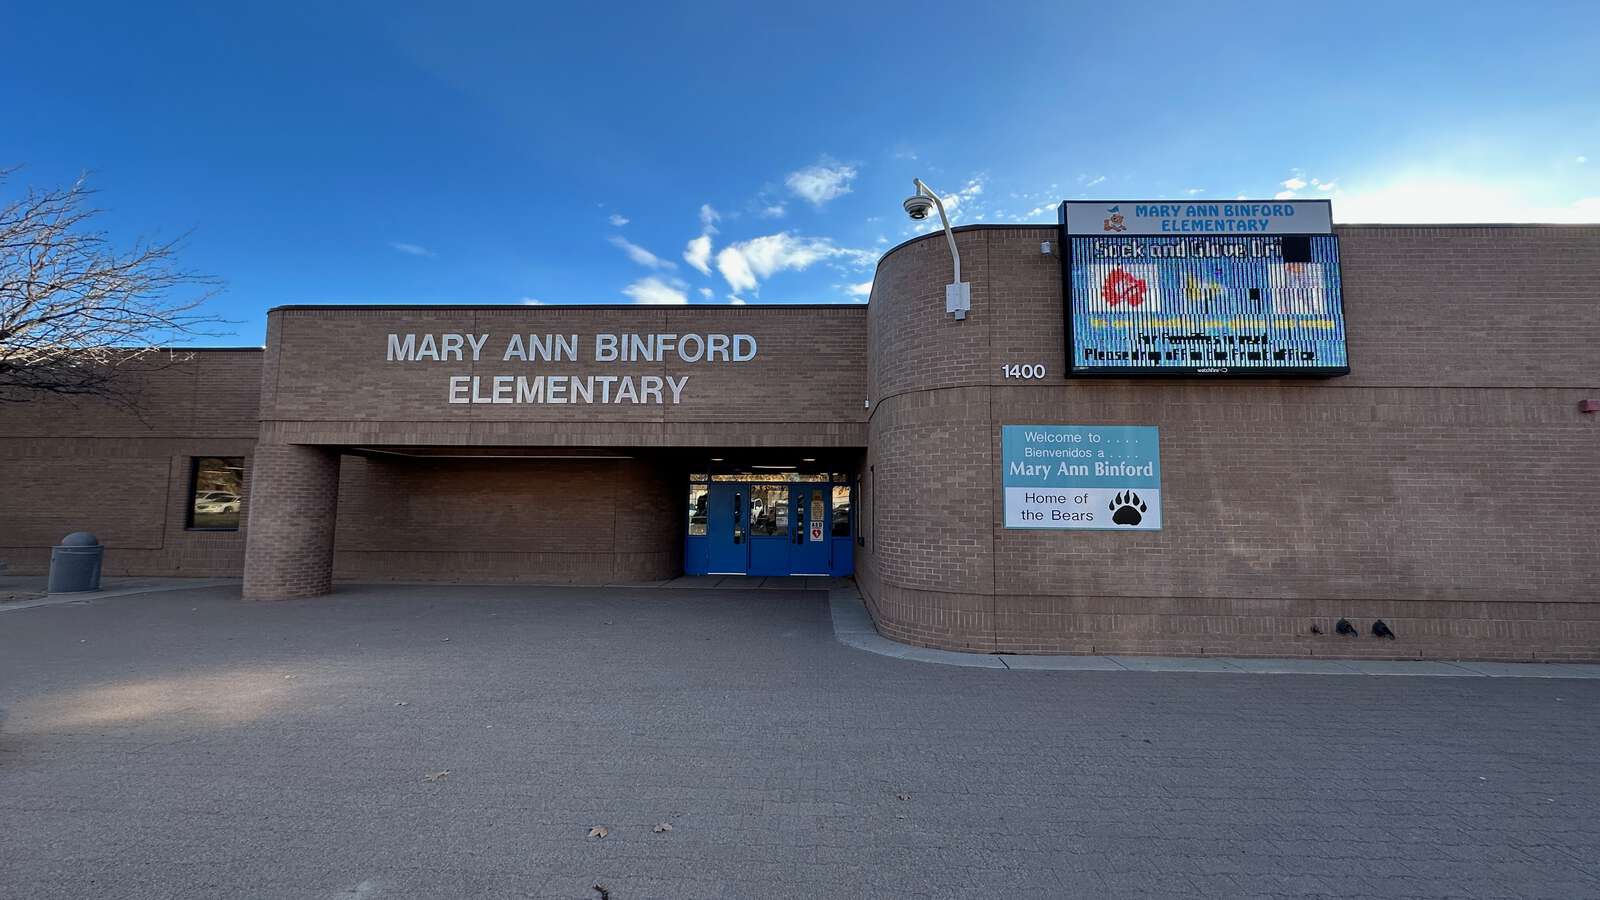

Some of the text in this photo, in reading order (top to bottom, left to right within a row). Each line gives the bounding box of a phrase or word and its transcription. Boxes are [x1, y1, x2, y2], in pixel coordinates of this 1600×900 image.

[1135, 204, 1295, 217] MARY ANN BINFORD
[1161, 219, 1269, 232] ELEMENTARY
[1150, 239, 1185, 258] and
[386, 333, 758, 362] MARY ANN BINFORD
[1084, 348, 1129, 360] Please
[1002, 364, 1046, 379] 1400
[448, 376, 689, 404] ELEMENTARY
[1024, 432, 1082, 443] Welcome
[1088, 432, 1101, 443] to
[1024, 447, 1092, 458] Bienvenidos
[1009, 461, 1153, 480] Mary Ann Binford
[1025, 493, 1088, 504] Home of
[1021, 509, 1094, 521] the Bears
